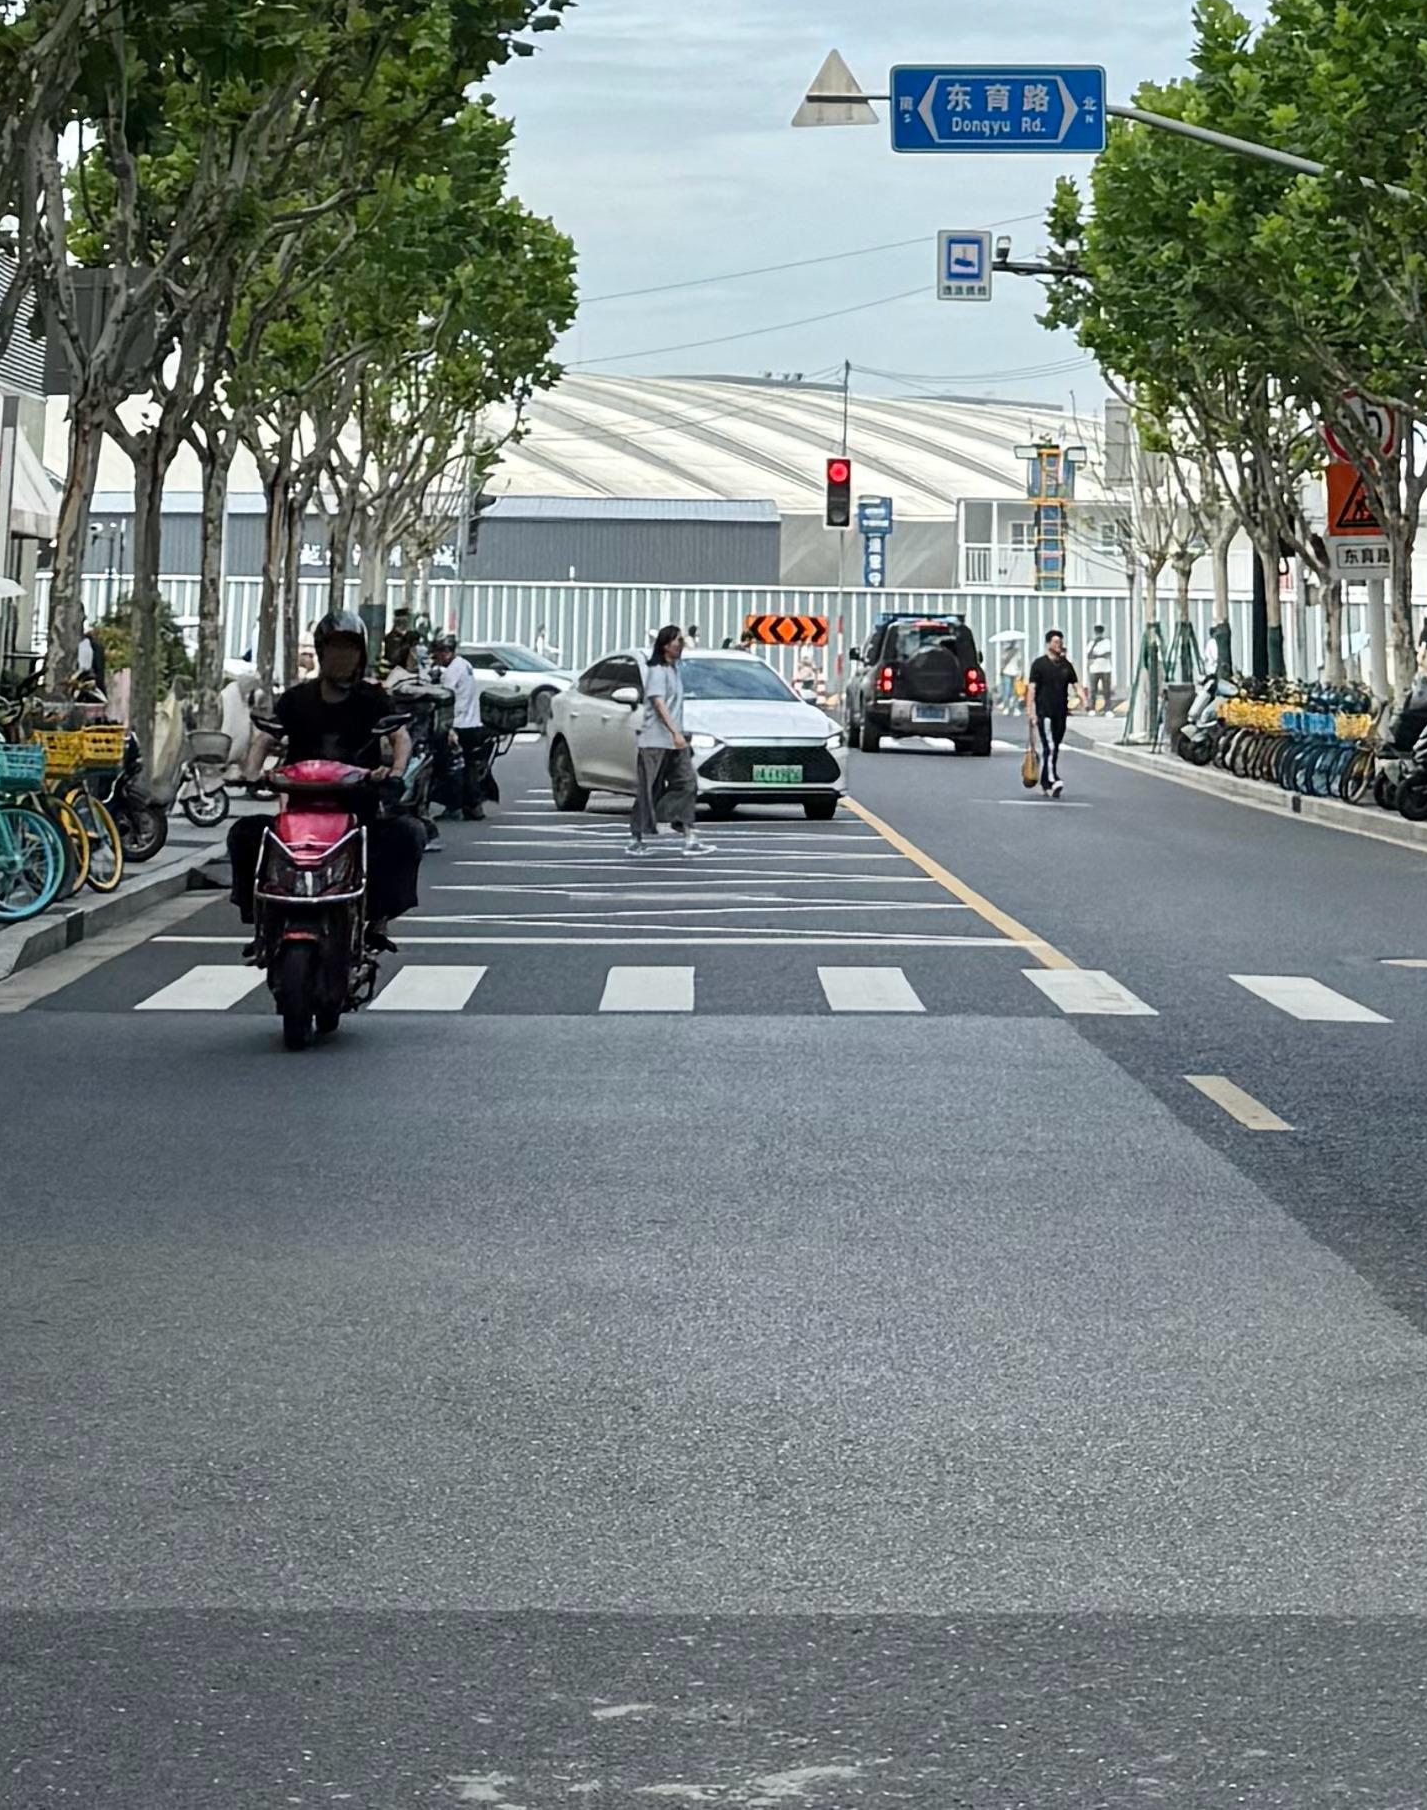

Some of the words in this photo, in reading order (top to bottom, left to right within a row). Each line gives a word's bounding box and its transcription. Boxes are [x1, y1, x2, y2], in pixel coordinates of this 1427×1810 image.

[946, 83, 1049, 112] 东育路
[1083, 97, 1098, 111] 北
[952, 116, 1011, 137] Dongyu
[1021, 116, 1046, 133] Rd.
[1085, 114, 1094, 124] N
